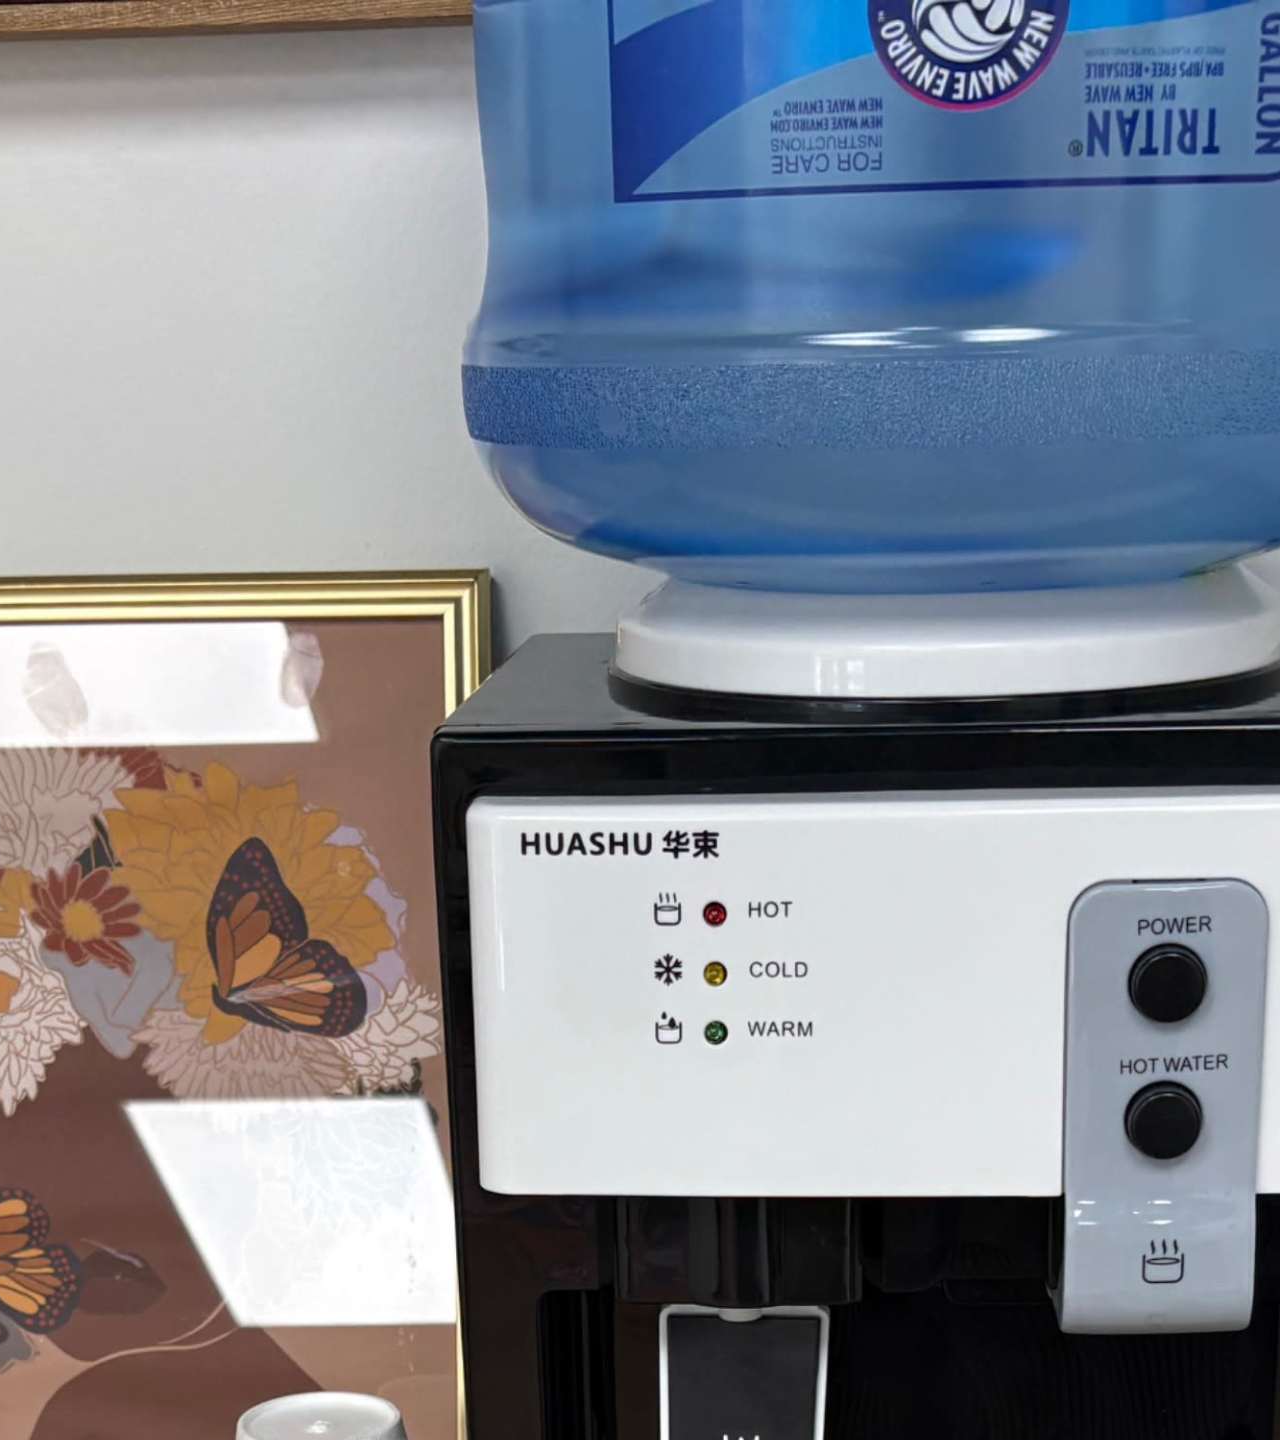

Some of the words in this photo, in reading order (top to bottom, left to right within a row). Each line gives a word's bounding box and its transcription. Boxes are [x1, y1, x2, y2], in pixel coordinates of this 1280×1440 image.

[1012, 10, 1056, 71] NEW
[953, 63, 1019, 100] WAVE
[1085, 85, 1120, 104] WAVE
[1124, 84, 1153, 101] NEW
[1161, 84, 1176, 100] BY
[827, 99, 857, 112] WAVE
[858, 97, 883, 111] NEW
[831, 117, 858, 130] WAVE
[860, 116, 883, 129] NEW
[771, 135, 883, 152] INSTRUCTIONS
[772, 154, 829, 175] CARE
[837, 152, 883, 171] FOR
[520, 832, 653, 856] HUASHU
[747, 901, 793, 918] HOT
[1138, 915, 1212, 936] POWER
[749, 961, 808, 978] COLD
[747, 1021, 813, 1037] WARM
[1120, 1058, 1159, 1074] HOT
[1163, 1054, 1229, 1072] WATER
